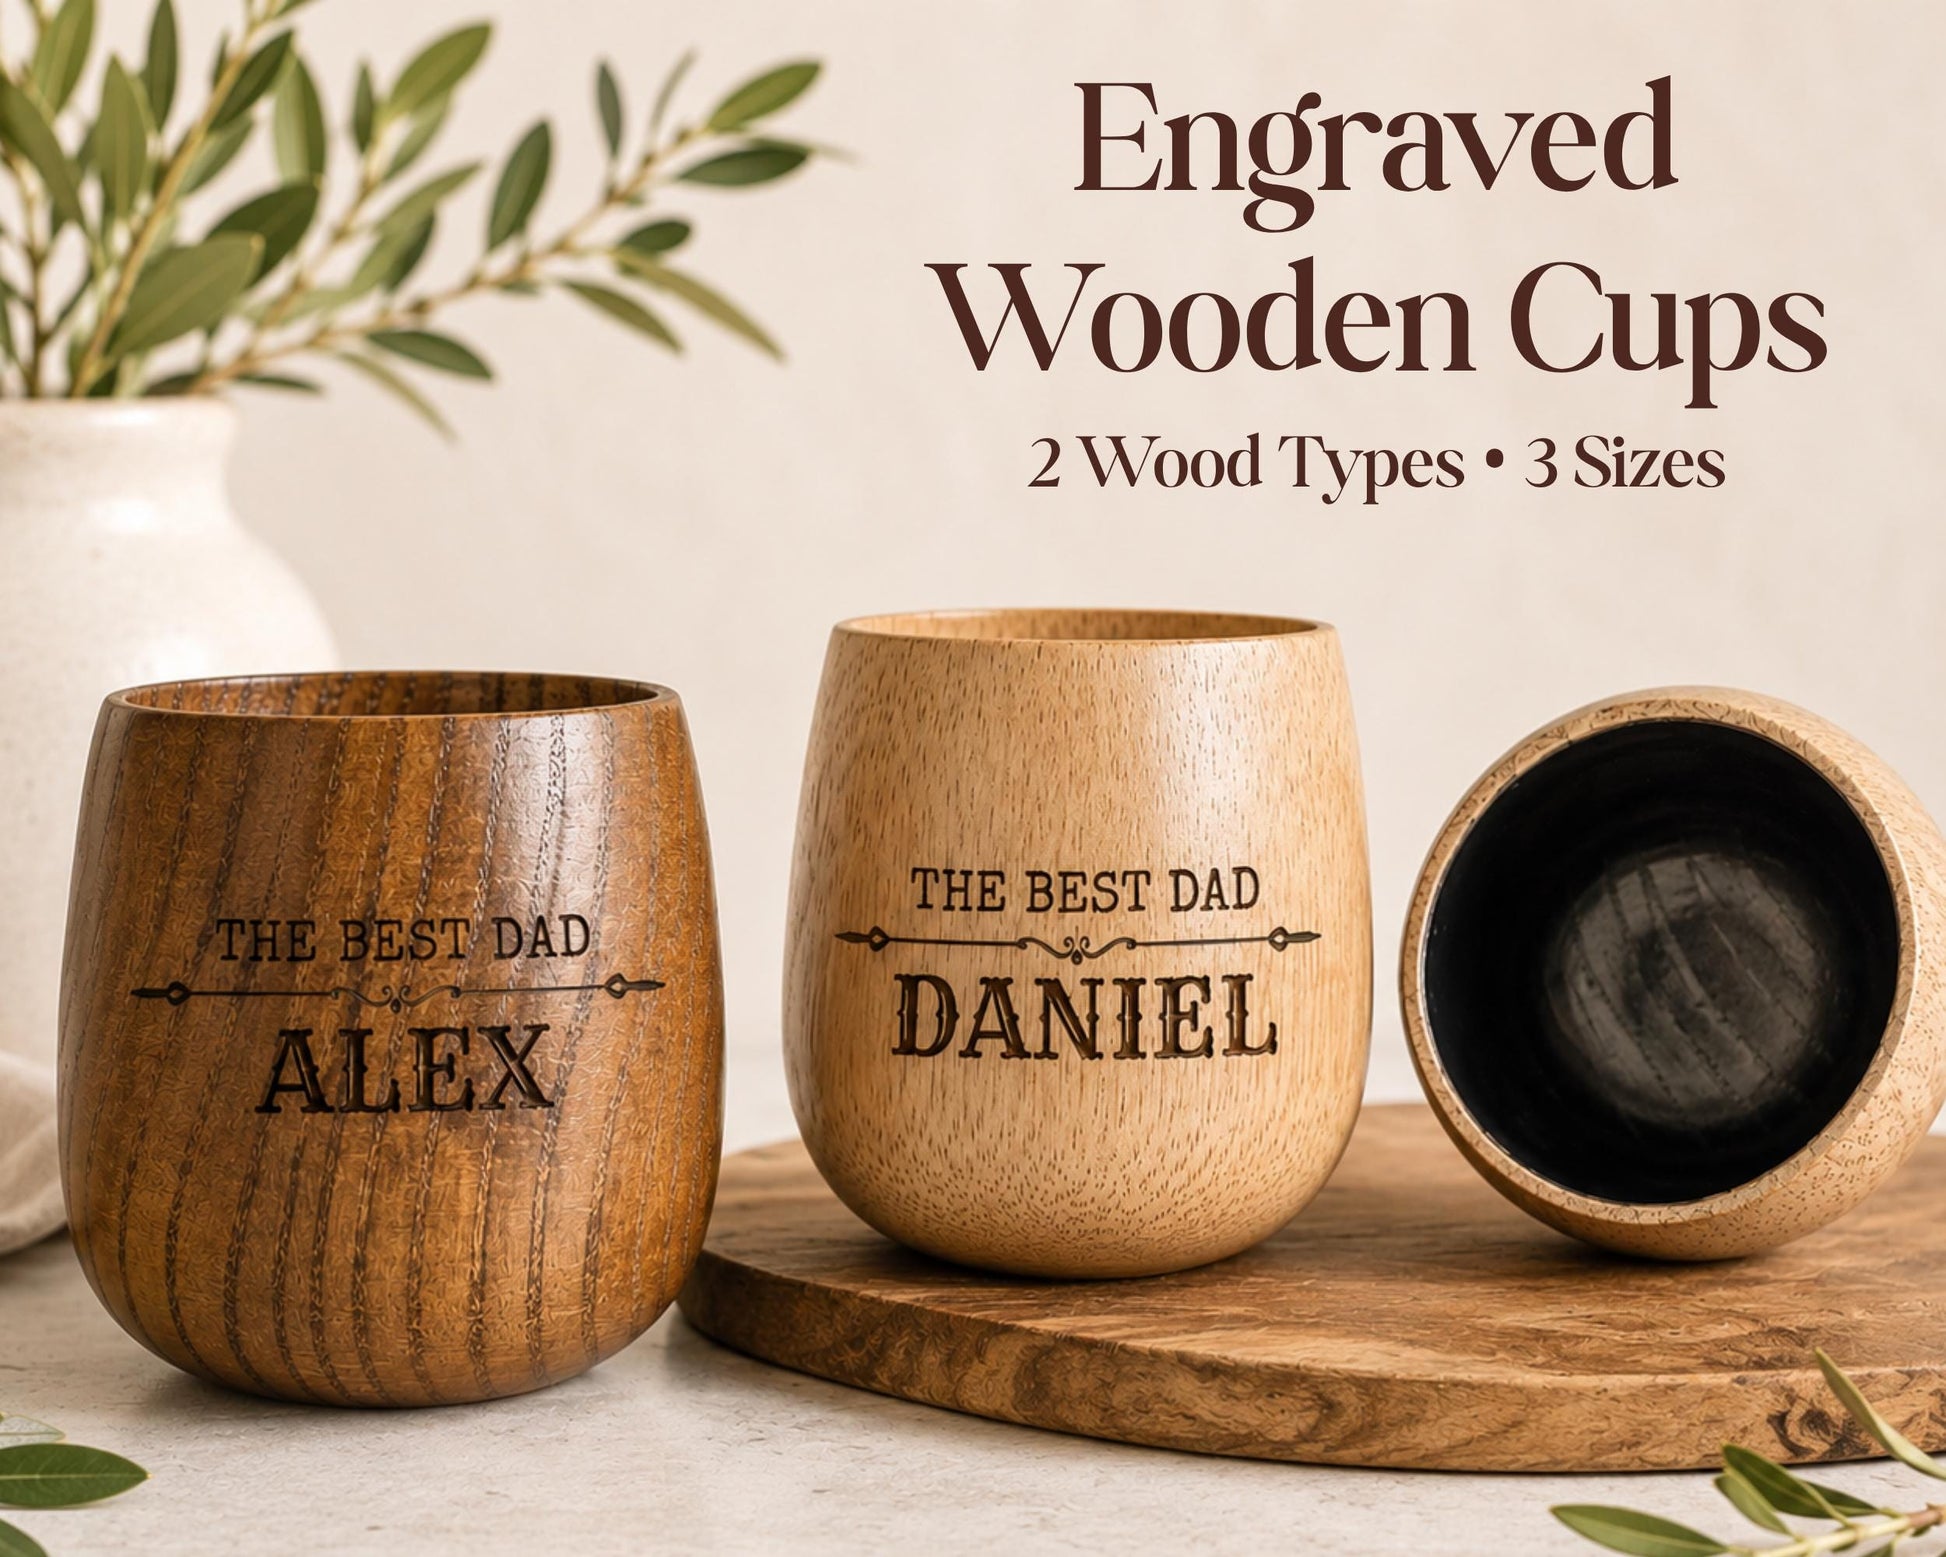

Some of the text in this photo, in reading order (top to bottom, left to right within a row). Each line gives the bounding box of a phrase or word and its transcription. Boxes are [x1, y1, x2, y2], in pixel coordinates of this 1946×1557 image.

[911, 866, 1261, 913] THE BEST DAD
[216, 914, 591, 962] THE BEST DAD
[891, 973, 1278, 1060] DANIEL
[255, 1024, 555, 1114] ALEX
